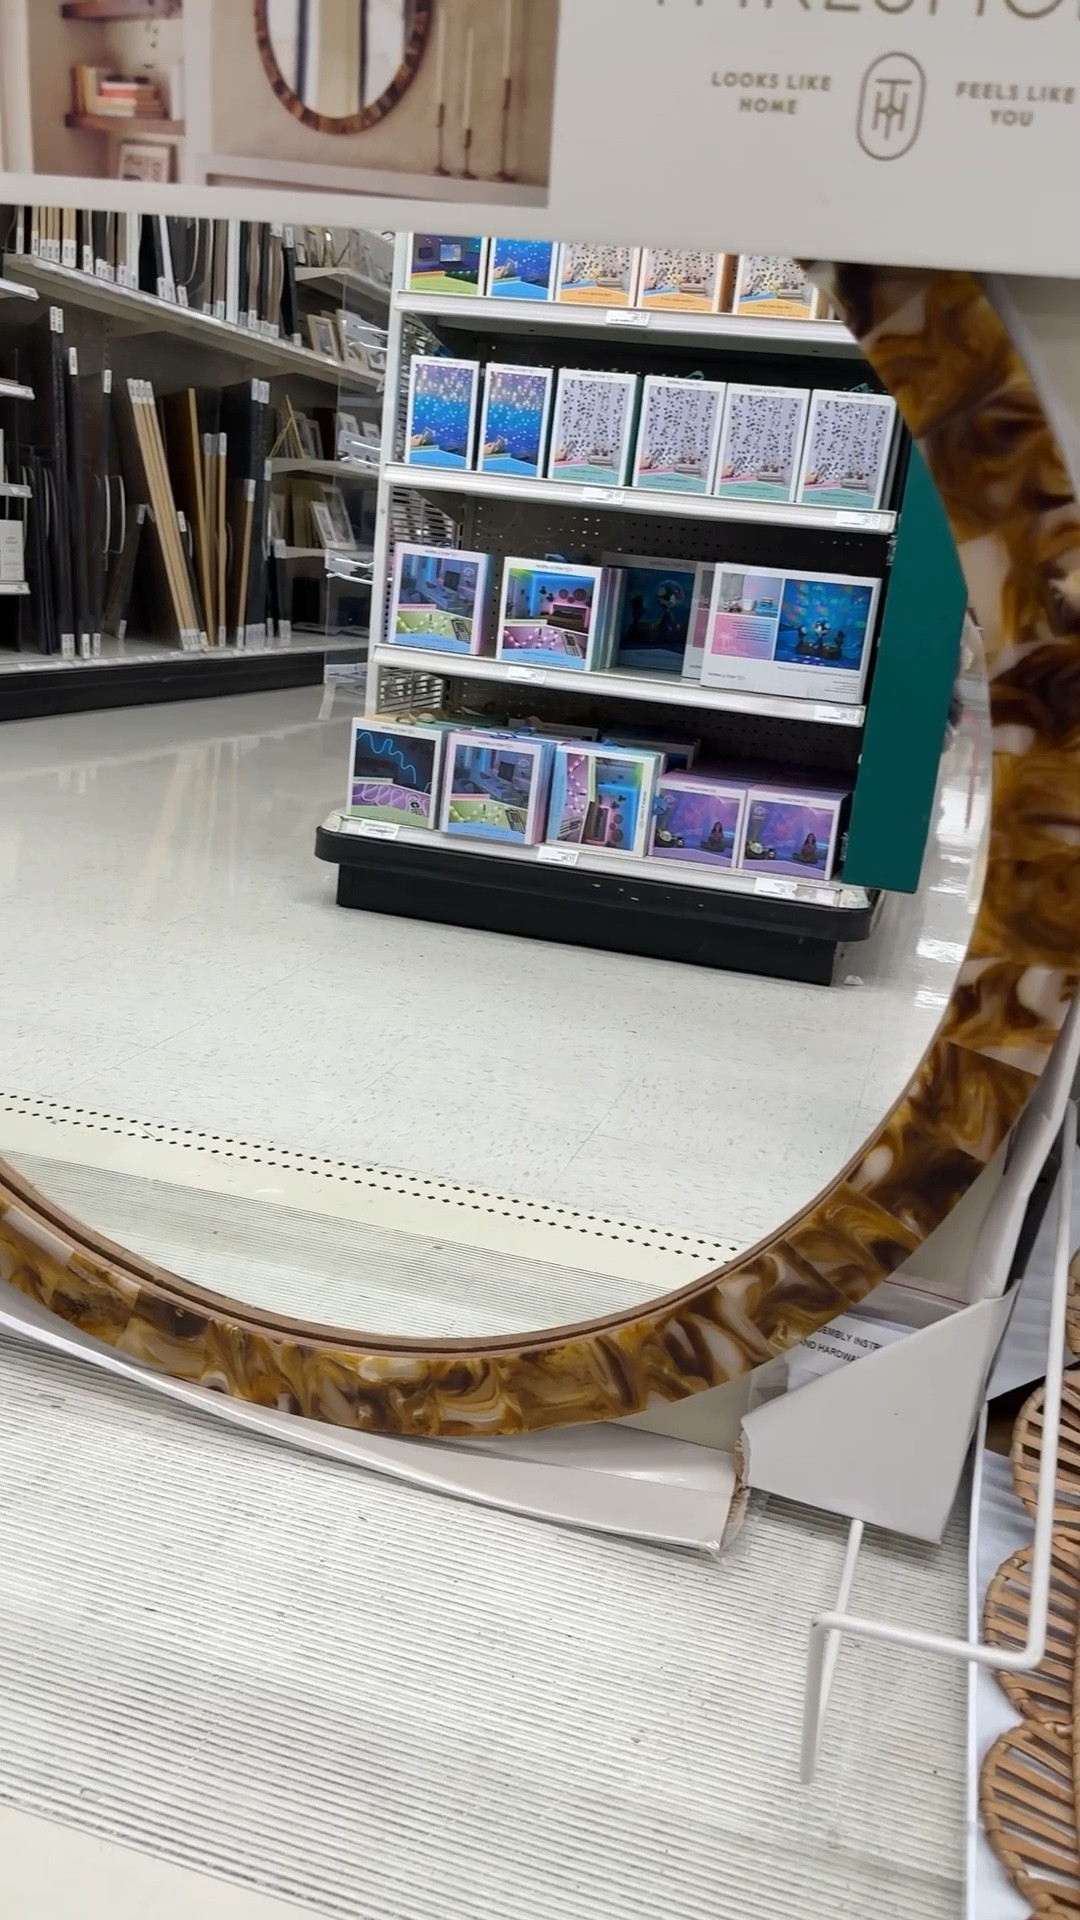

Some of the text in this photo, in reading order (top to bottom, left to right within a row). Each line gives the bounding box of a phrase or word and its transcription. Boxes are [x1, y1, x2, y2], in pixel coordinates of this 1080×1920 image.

[711, 72, 832, 92] LOOKS LIKE
[956, 81, 1077, 104] FEELS LIKE
[739, 98, 798, 115] HOME
[990, 109, 1034, 127] YOU
[818, 1343, 861, 1362] HARDWA
[854, 1337, 884, 1351] INSTR
